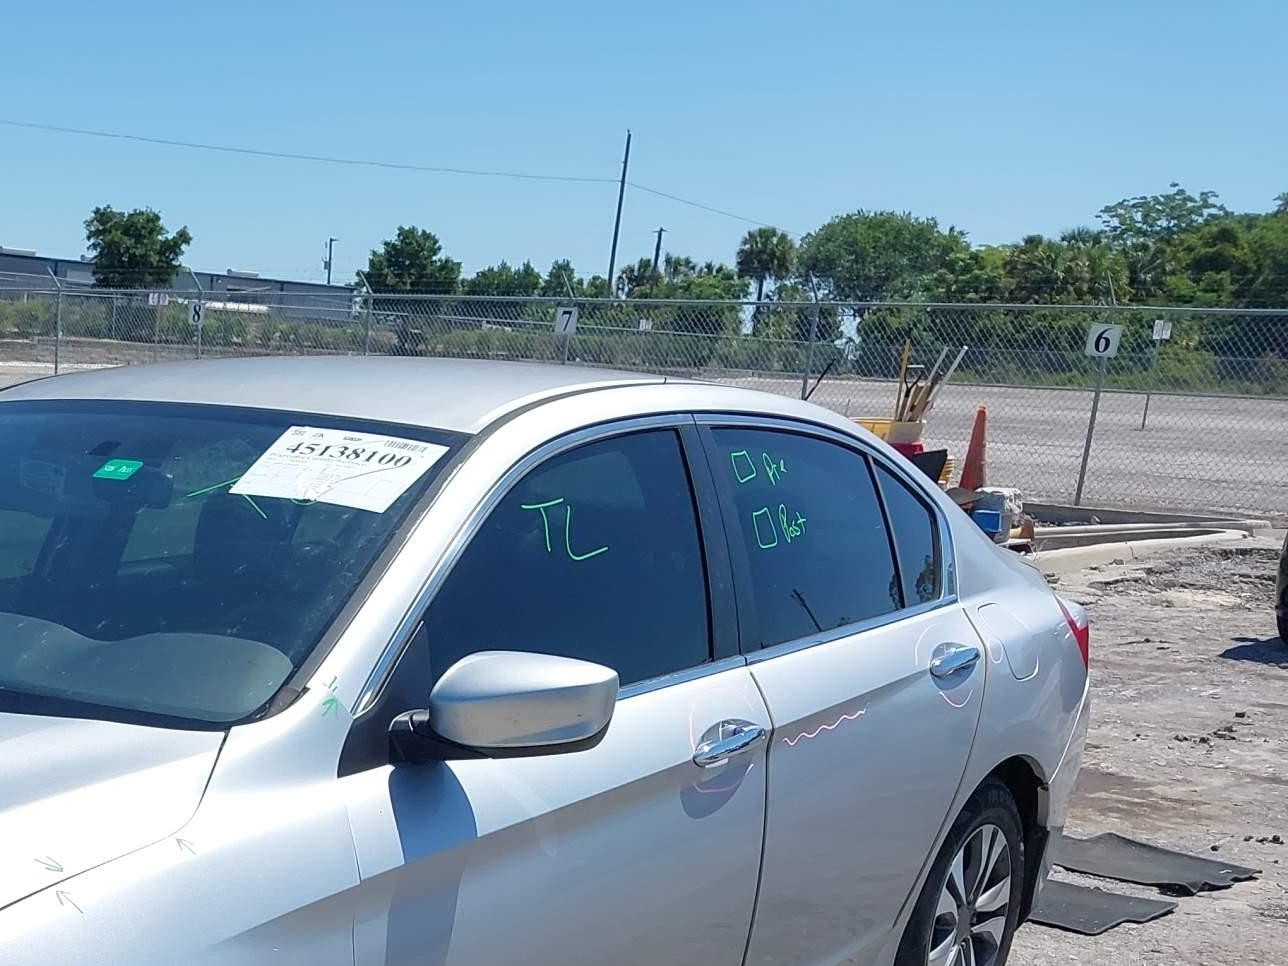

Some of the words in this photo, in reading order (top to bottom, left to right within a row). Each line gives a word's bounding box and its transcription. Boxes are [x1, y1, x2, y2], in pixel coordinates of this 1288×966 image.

[192, 303, 202, 323] 8
[562, 310, 573, 332] 7
[1094, 327, 1113, 353] 6
[286, 441, 412, 468] 45138100
[520, 497, 610, 561] TL
